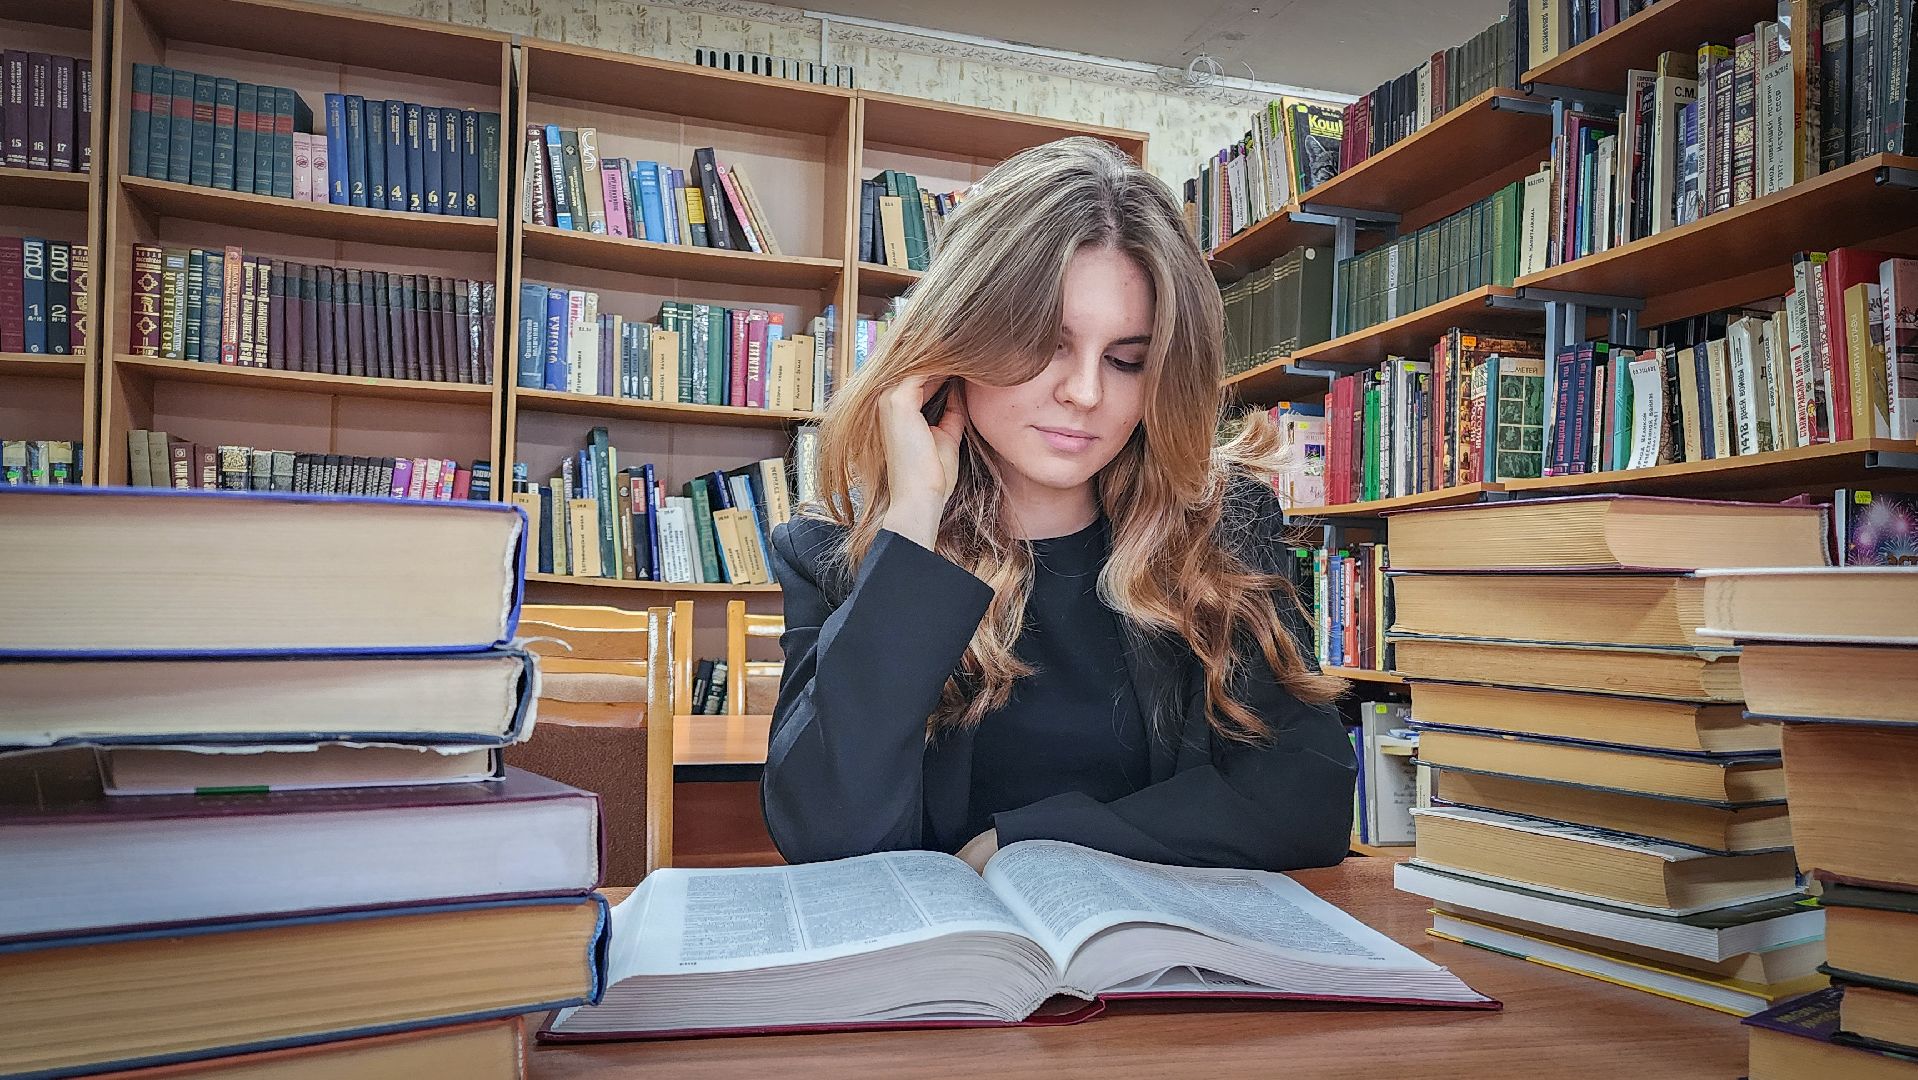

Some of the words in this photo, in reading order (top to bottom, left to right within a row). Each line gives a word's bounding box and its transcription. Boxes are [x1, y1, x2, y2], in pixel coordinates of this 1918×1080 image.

[11, 139, 21, 147] 15
[34, 142, 44, 151] 16
[57, 143, 66, 152] 17
[335, 181, 342, 193] 1
[353, 182, 363, 193] 2
[374, 185, 383, 197] 3
[392, 185, 402, 197] 4
[411, 193, 420, 206] 5
[428, 190, 438, 203] 6
[448, 192, 457, 204] 7
[466, 193, 476, 206] 8
[28, 304, 39, 316] 1
[1882, 288, 1890, 320] ВЕКА
[51, 305, 67, 317] 2
[162, 272, 176, 351] ВОЕННЫЙ
[1850, 313, 1858, 343] СЛАВЫ
[1884, 325, 1891, 341] НА
[548, 316, 560, 364] ФИЗИКА
[1853, 352, 1861, 388] ПАМЯТИ
[1737, 368, 1747, 397] ВОЙНЫ
[1884, 347, 1896, 414] ДОБЛЕСТЬ
[1739, 398, 1748, 420] ДНЕЙ
[1741, 423, 1750, 453] 1418
